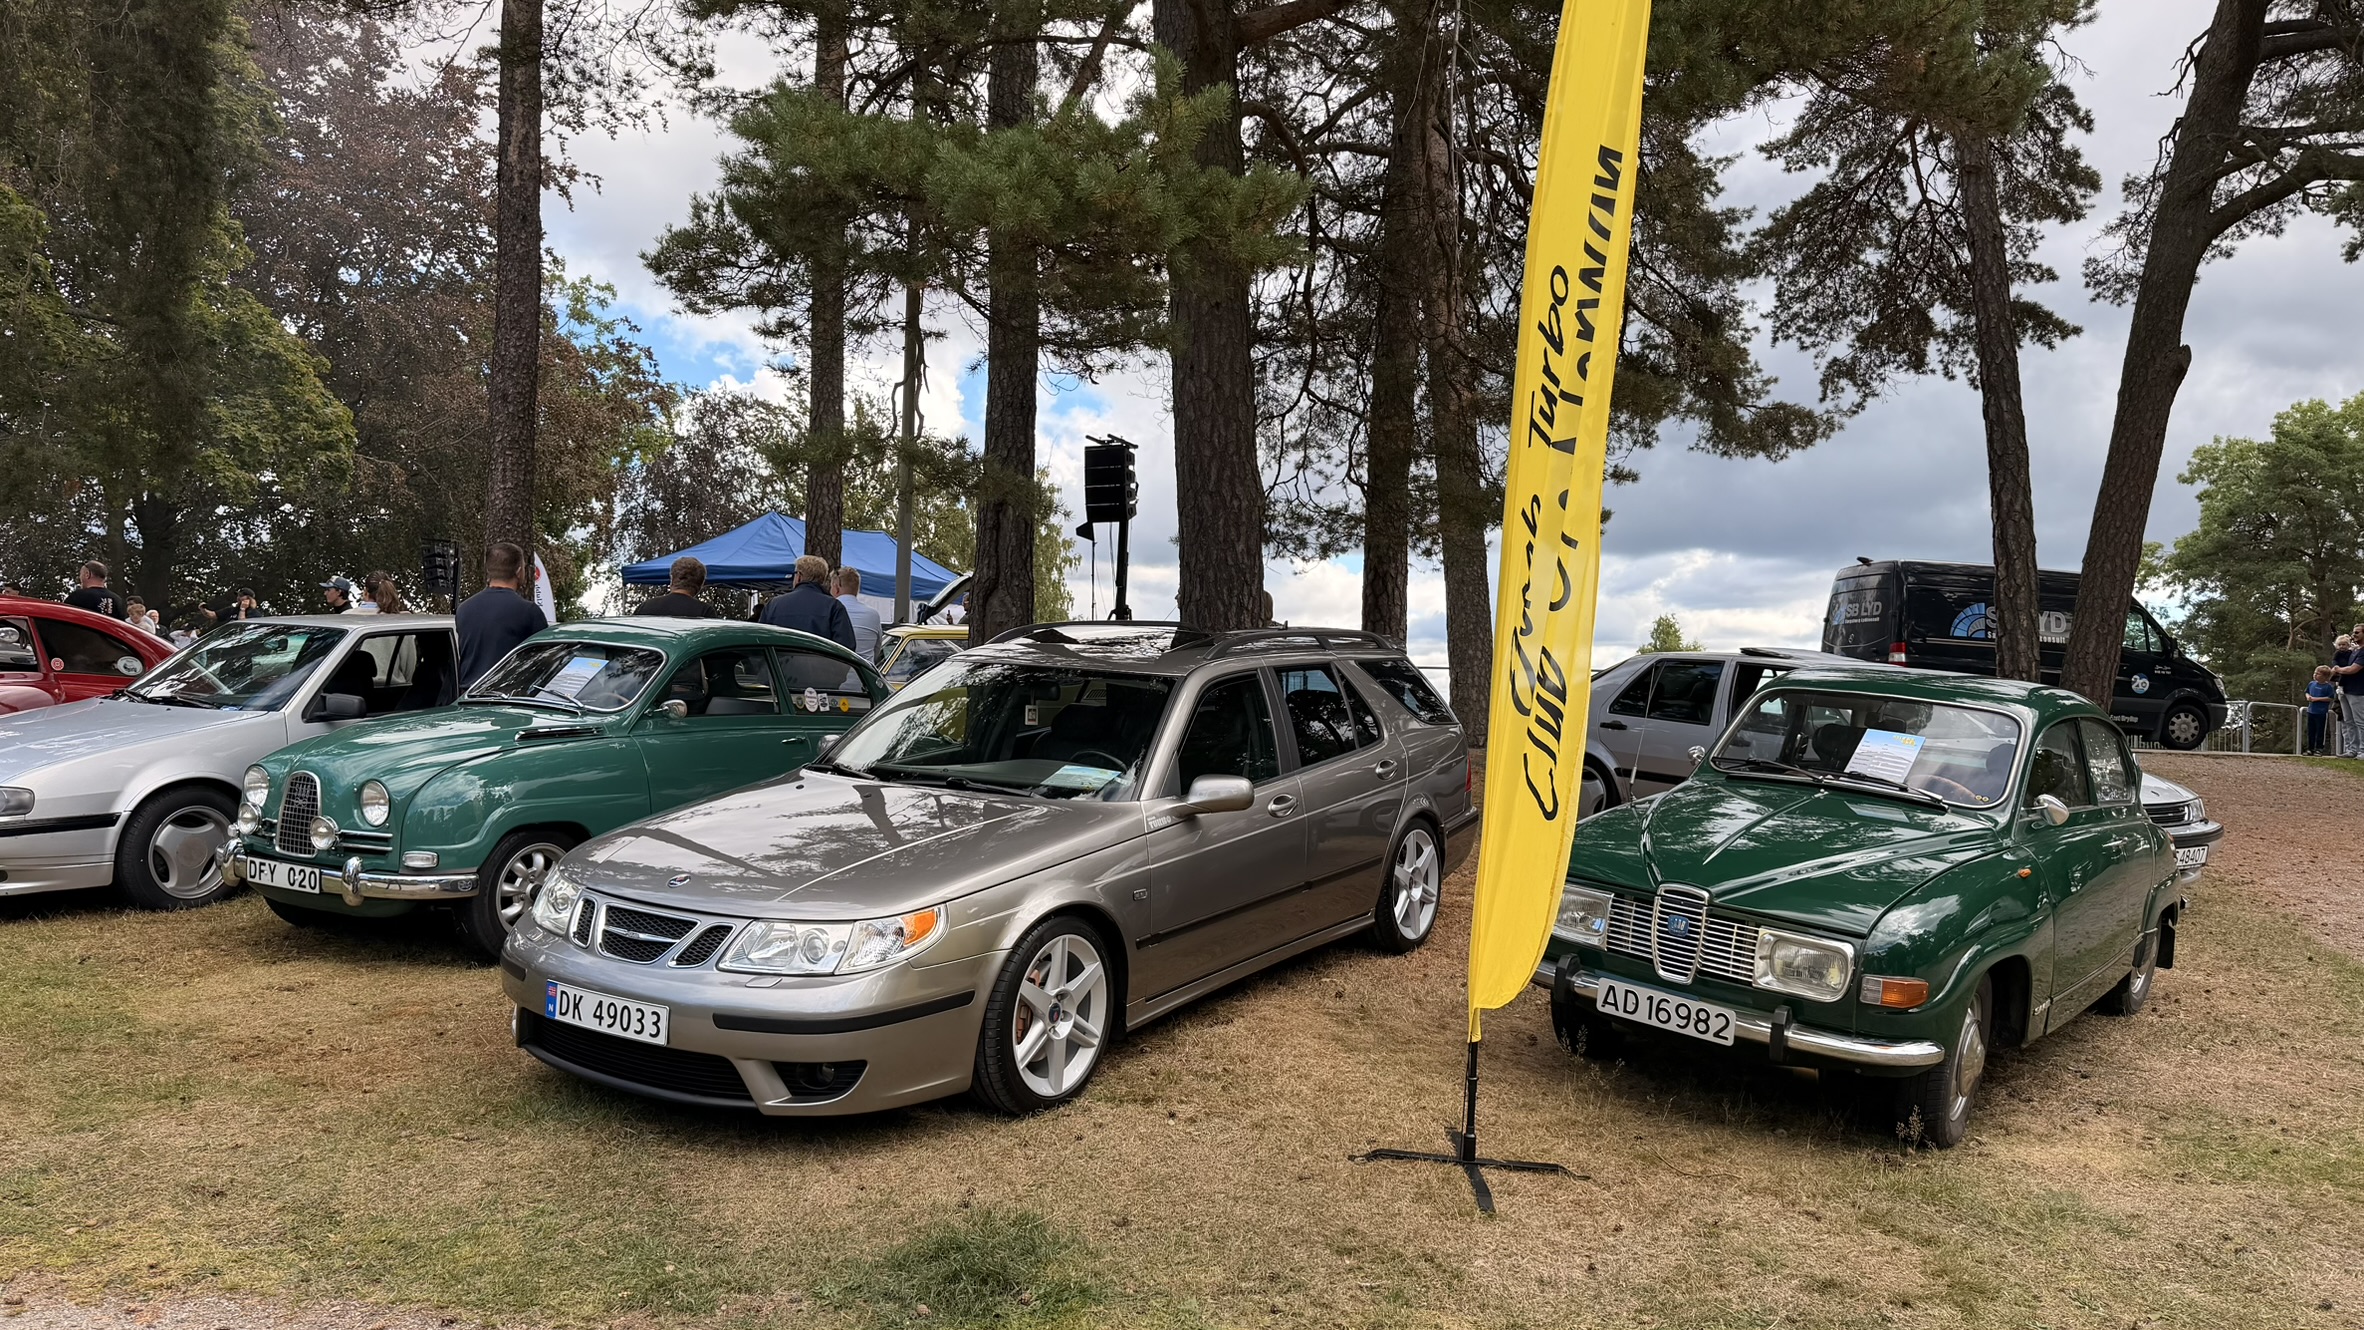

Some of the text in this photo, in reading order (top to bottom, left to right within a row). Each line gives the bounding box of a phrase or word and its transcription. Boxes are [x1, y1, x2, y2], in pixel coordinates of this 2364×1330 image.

[1528, 265, 1569, 449] Turbo
[1845, 601, 1882, 617] SB LYD
[1986, 606, 2067, 633] S YD
[1523, 646, 1567, 821] Club
[2179, 847, 2206, 865] 48407
[249, 860, 317, 890] DFY 020
[548, 1004, 554, 1013] N
[559, 990, 661, 1039] DK 49033
[1601, 984, 1731, 1041] AD 16982
